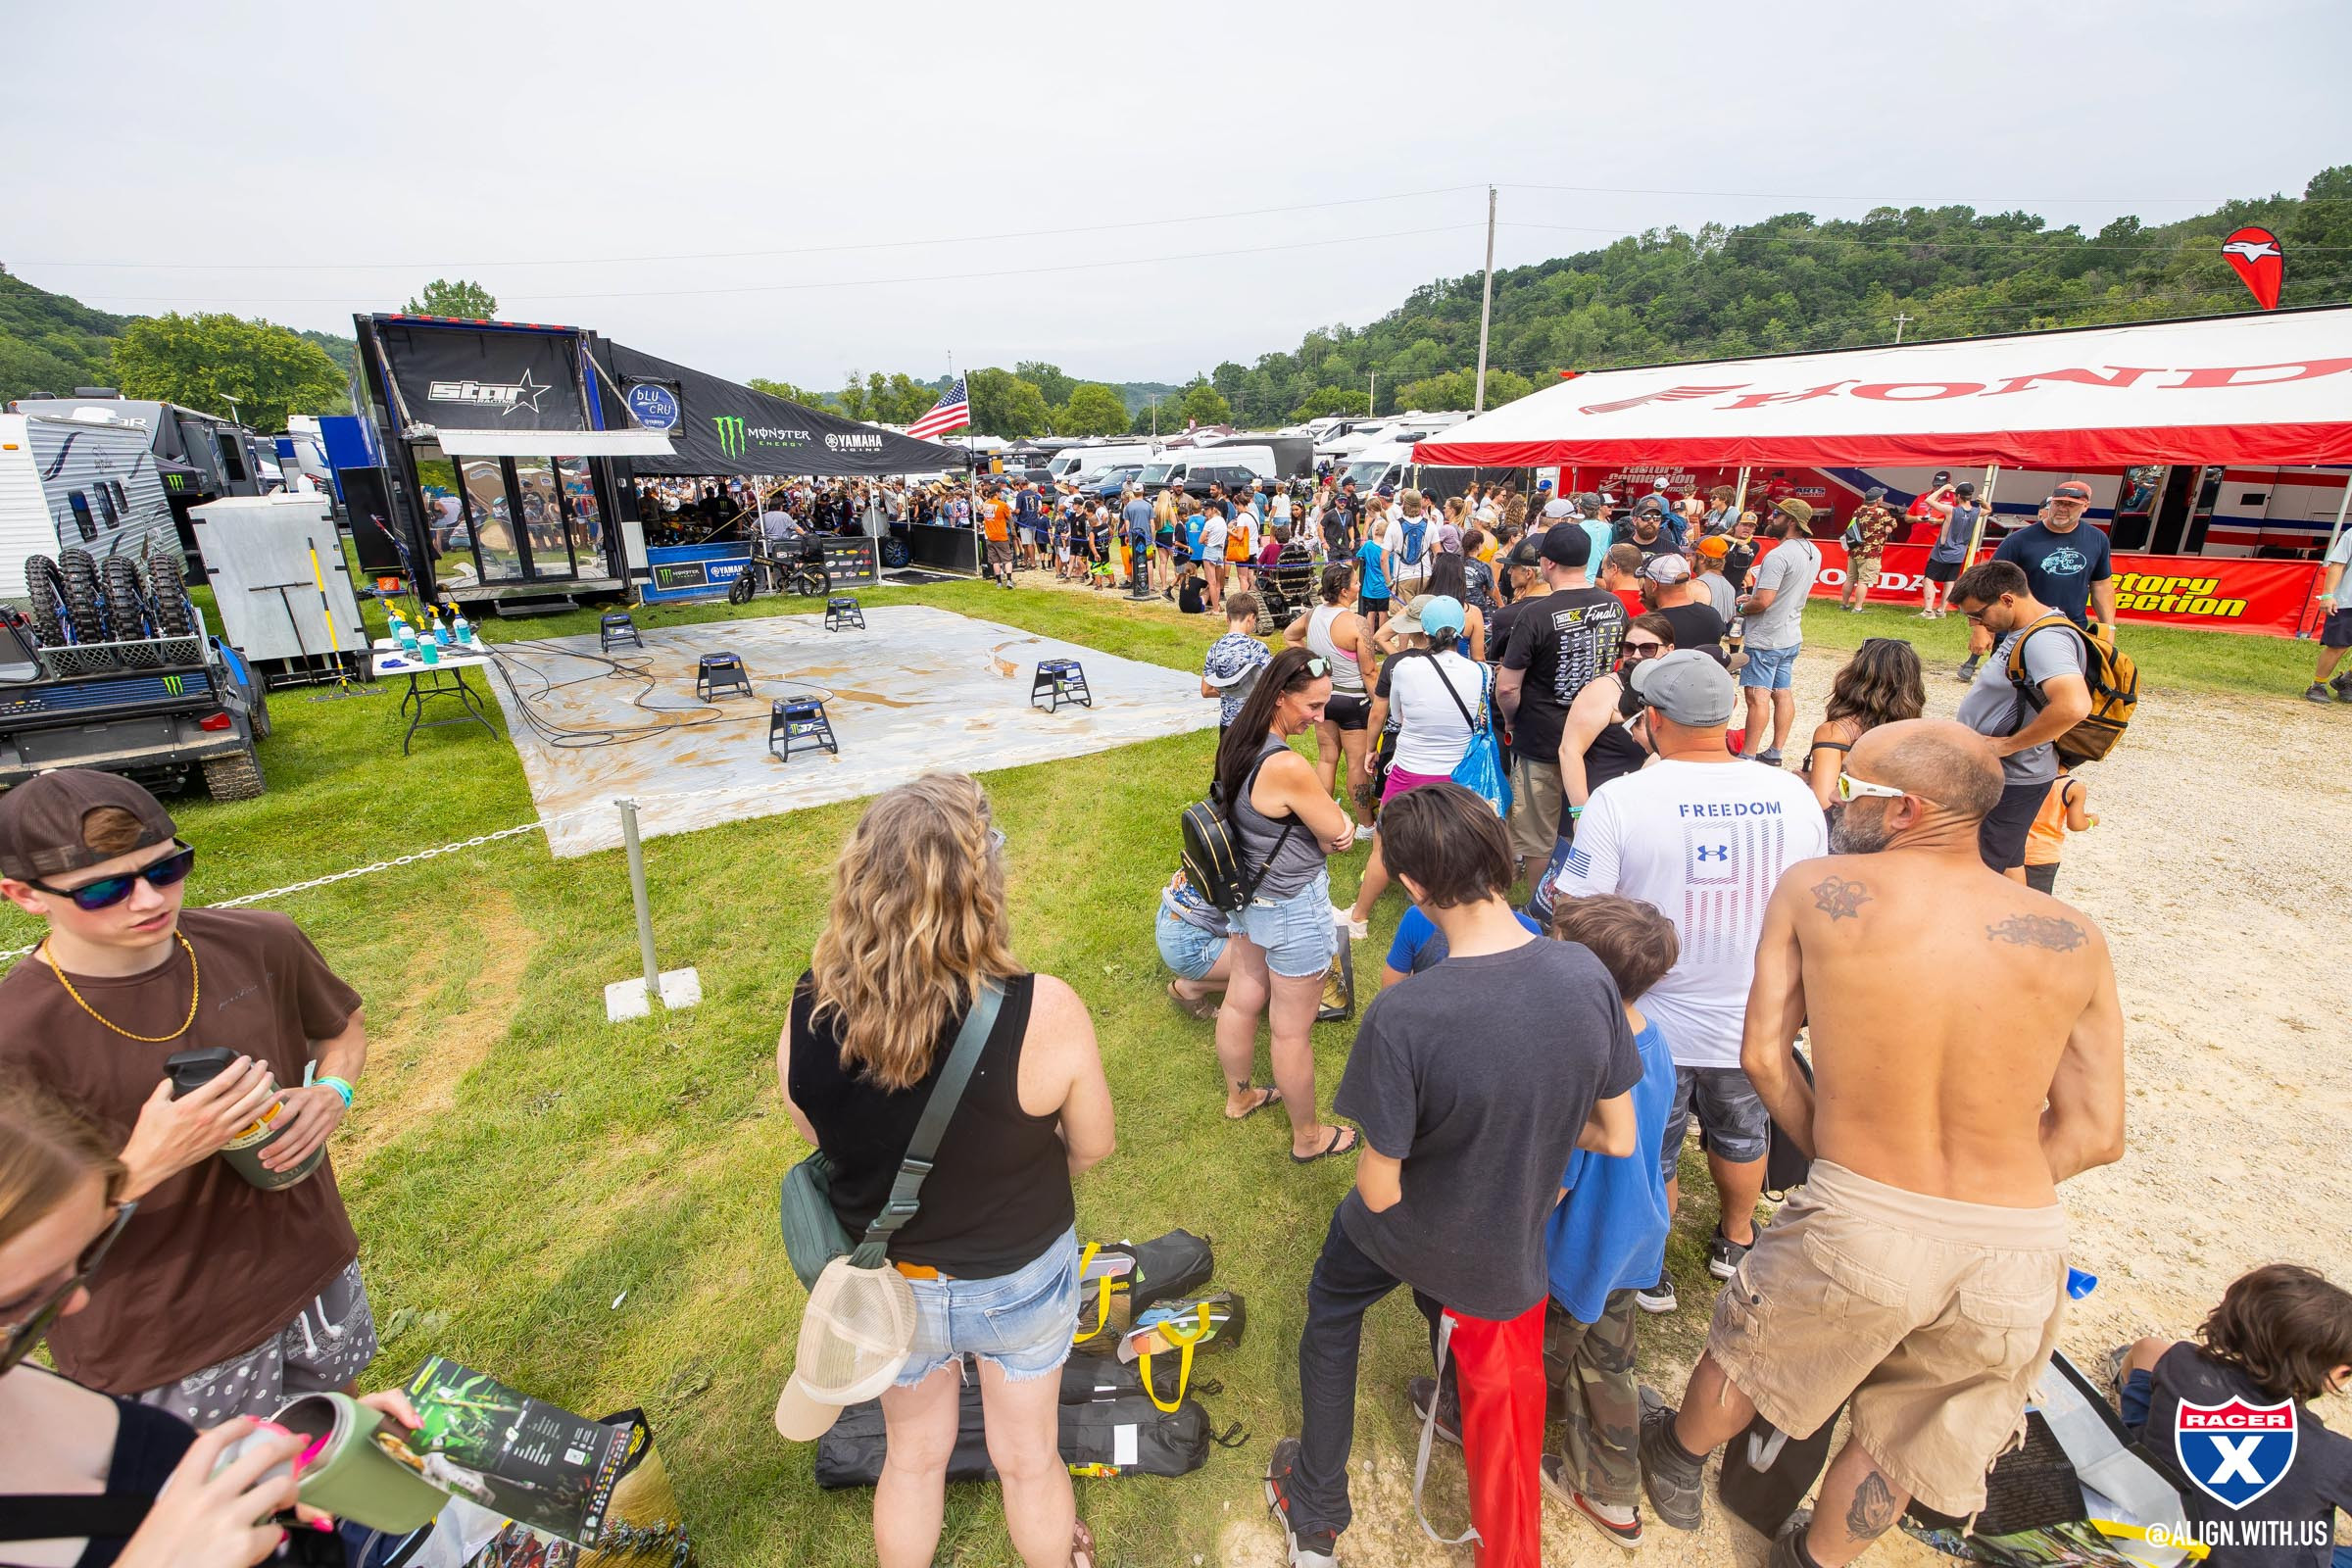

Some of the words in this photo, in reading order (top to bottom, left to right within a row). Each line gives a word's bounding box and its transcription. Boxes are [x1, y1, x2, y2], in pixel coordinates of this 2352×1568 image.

[1713, 357, 2352, 411] HOND
[837, 434, 883, 448] YAMAHA
[718, 564, 744, 575] YAMAH
[2112, 592, 2249, 618] ection
[1679, 801, 1783, 818] FREEDOM
